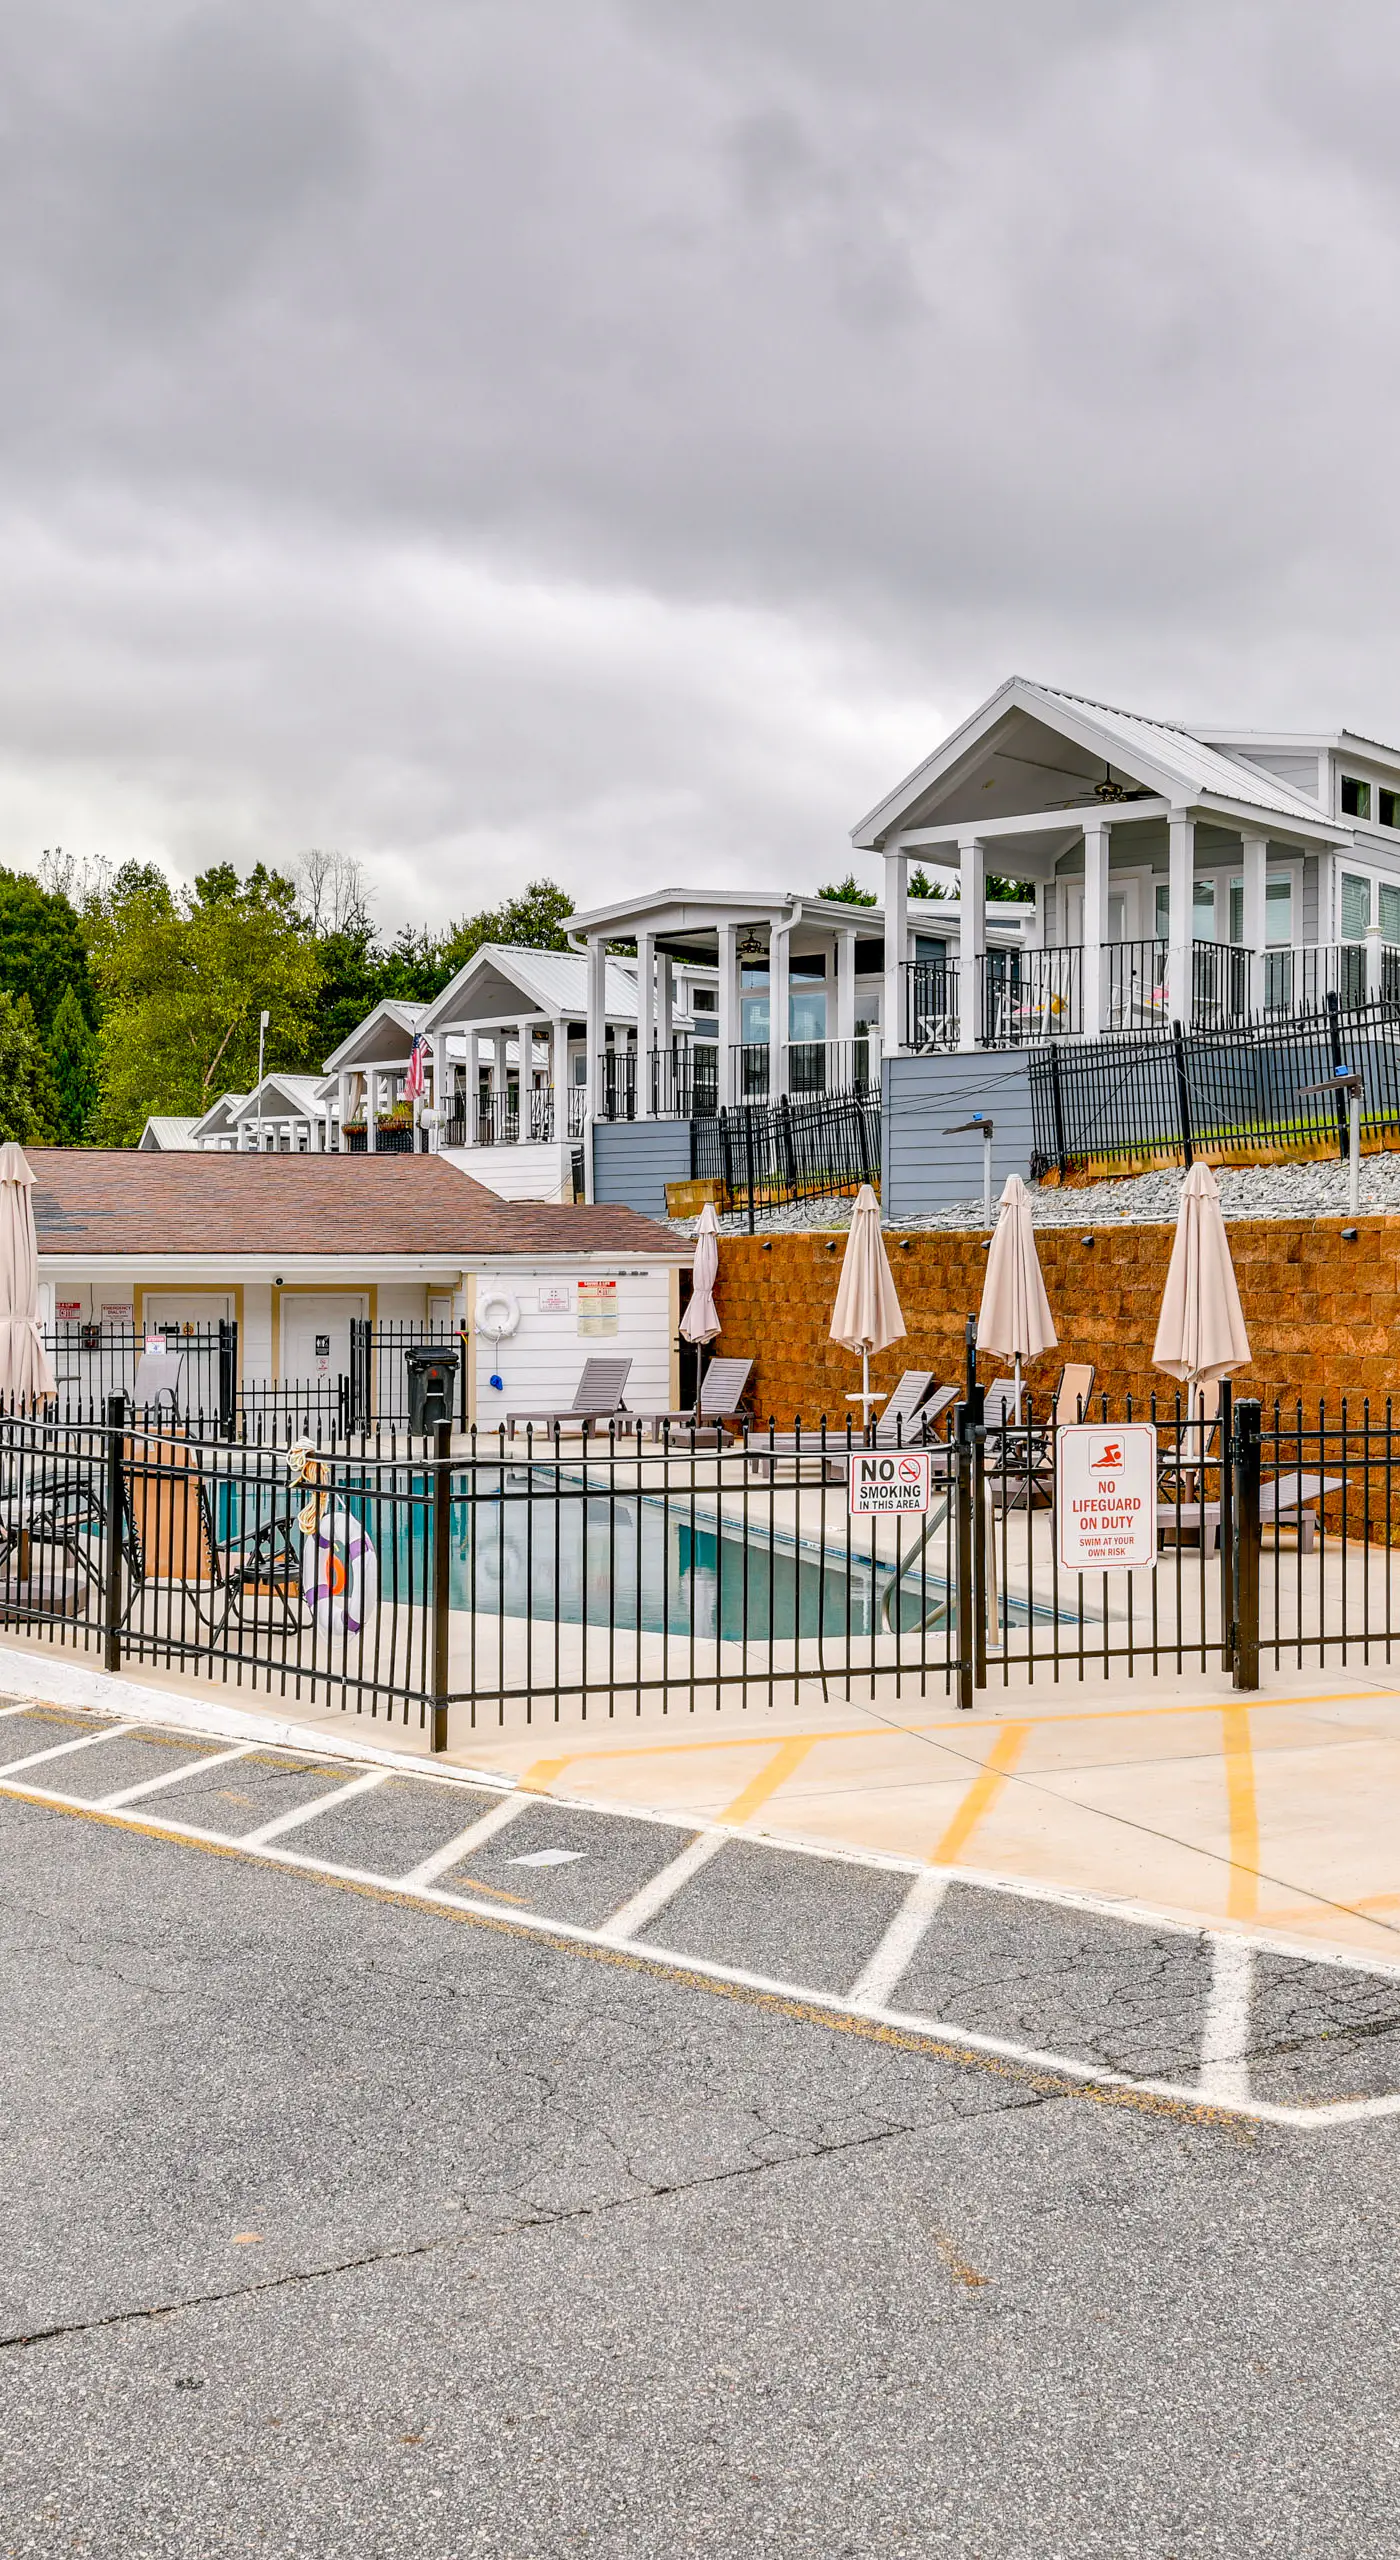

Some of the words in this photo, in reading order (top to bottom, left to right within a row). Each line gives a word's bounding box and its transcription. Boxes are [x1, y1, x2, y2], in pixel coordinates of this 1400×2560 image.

[861, 1459, 895, 1481] NO
[860, 1485, 921, 1499] SMOKING
[1098, 1480, 1115, 1494] NO
[859, 1501, 869, 1510] IN
[872, 1500, 894, 1509] THIS
[896, 1500, 920, 1509] AREA
[1072, 1497, 1141, 1513] LIFEGUARD
[1080, 1517, 1097, 1530] ON
[1101, 1516, 1134, 1529] DUTY
[1079, 1538, 1101, 1547] SWIM
[1103, 1537, 1112, 1546] AT
[1114, 1536, 1134, 1545] YOUR
[1088, 1548, 1105, 1557] OWN
[1107, 1547, 1126, 1556] RISK
